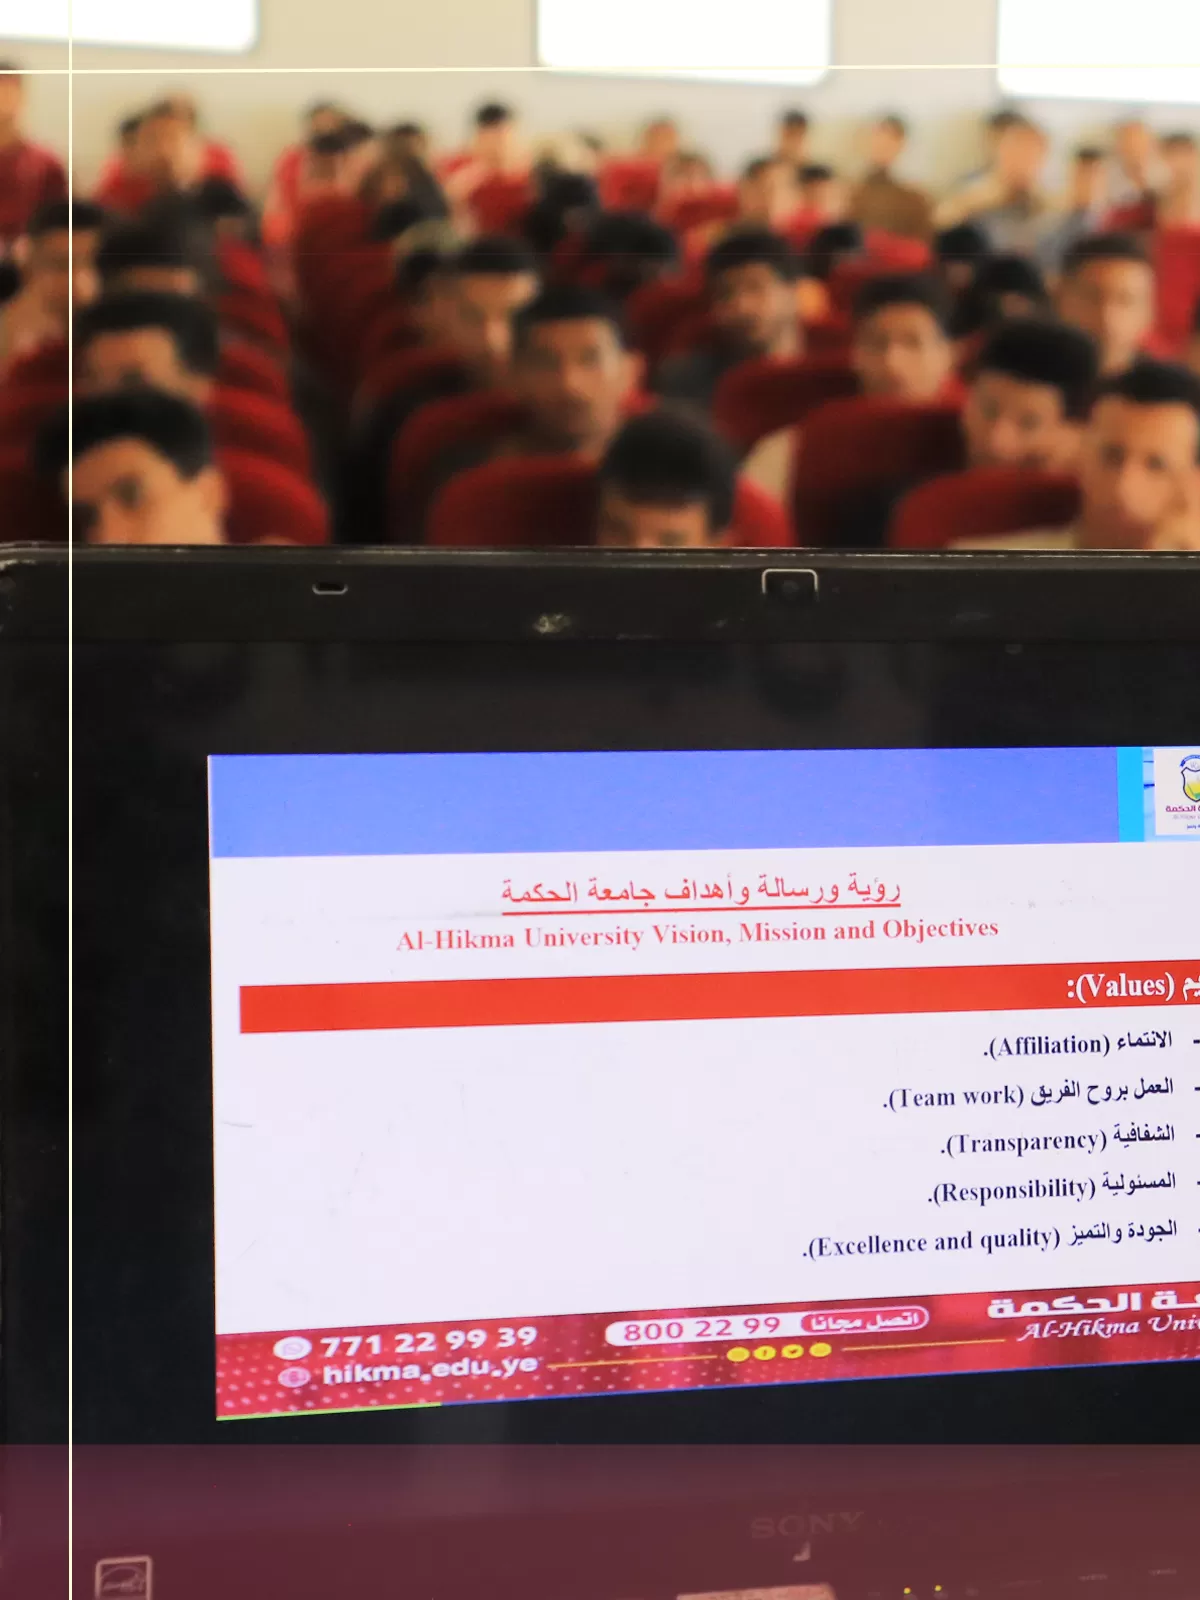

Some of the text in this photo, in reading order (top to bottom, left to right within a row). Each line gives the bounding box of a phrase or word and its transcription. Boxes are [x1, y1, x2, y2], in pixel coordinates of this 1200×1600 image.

[501, 872, 901, 907] رؤية ورسالة وأهداف جامعة الحكمة
[396, 918, 1000, 952] Al-Hikma University Vision, Mission and Objectives
[1117, 1030, 1173, 1051] الانتماء
[1030, 1078, 1081, 1107] الفريق
[1086, 1083, 1129, 1105] بروح
[1133, 1076, 1174, 1099] العمل
[1113, 1124, 1176, 1148] الشفافية
[1102, 1171, 1177, 1195] المسئولية
[934, 1232, 973, 1252] and
[1067, 1222, 1123, 1247] والتميز
[1127, 1219, 1178, 1244] الجودة
[987, 1292, 1143, 1319] الحكمة
[623, 1316, 782, 1342] 800 22 99
[810, 1311, 920, 1333] اتصل مجانا
[1016, 1317, 1141, 1343] Al-Hikma
[320, 1326, 539, 1358] 771 22 99 39
[322, 1355, 540, 1386] hikma.edu.ye
[750, 1511, 866, 1540] SONY
